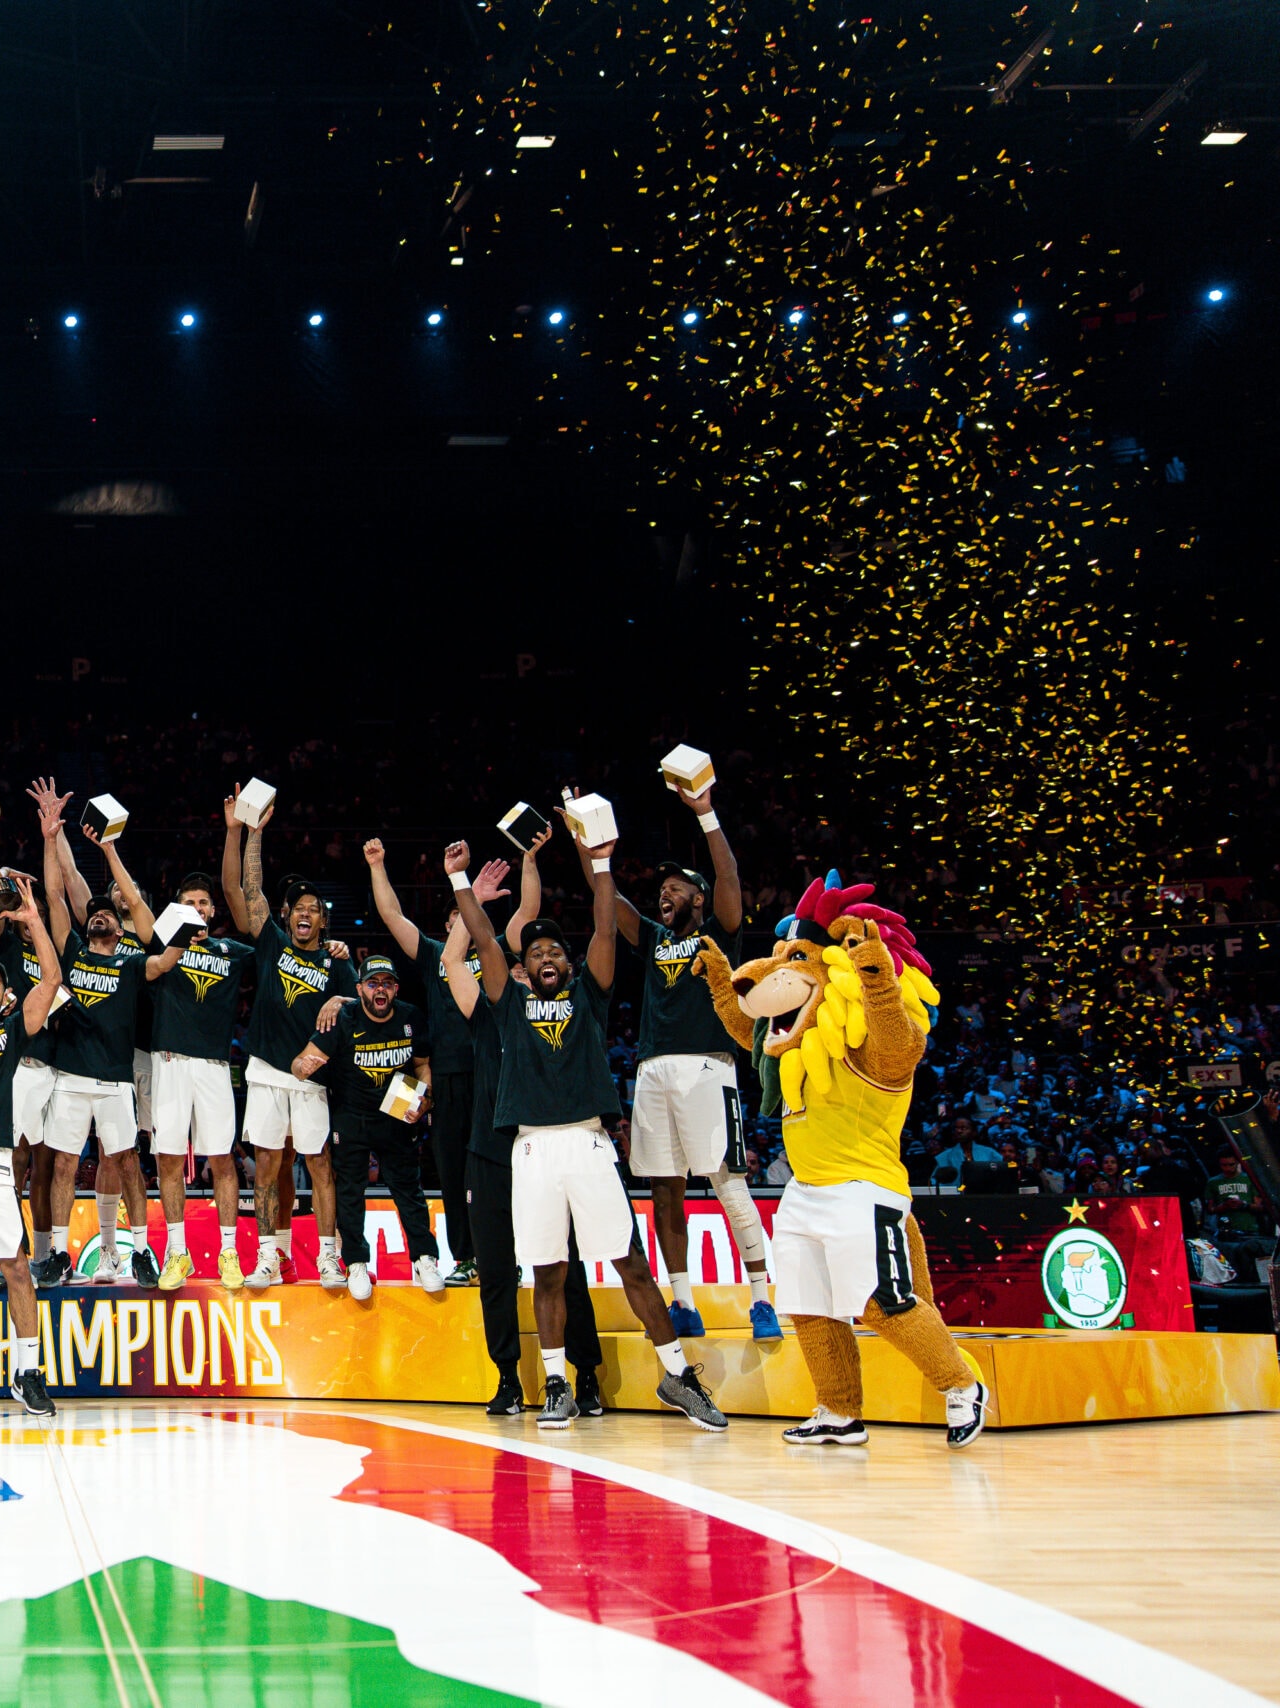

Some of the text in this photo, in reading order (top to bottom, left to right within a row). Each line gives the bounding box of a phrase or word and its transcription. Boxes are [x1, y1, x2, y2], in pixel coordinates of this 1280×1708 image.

[71, 656, 92, 682] P
[1225, 938, 1243, 957] F
[69, 968, 120, 993] CHAMPIONS
[277, 952, 329, 992] CHAMPIONS
[353, 1046, 413, 1067] CHAMPIONS
[1218, 1183, 1248, 1195] BOSTON
